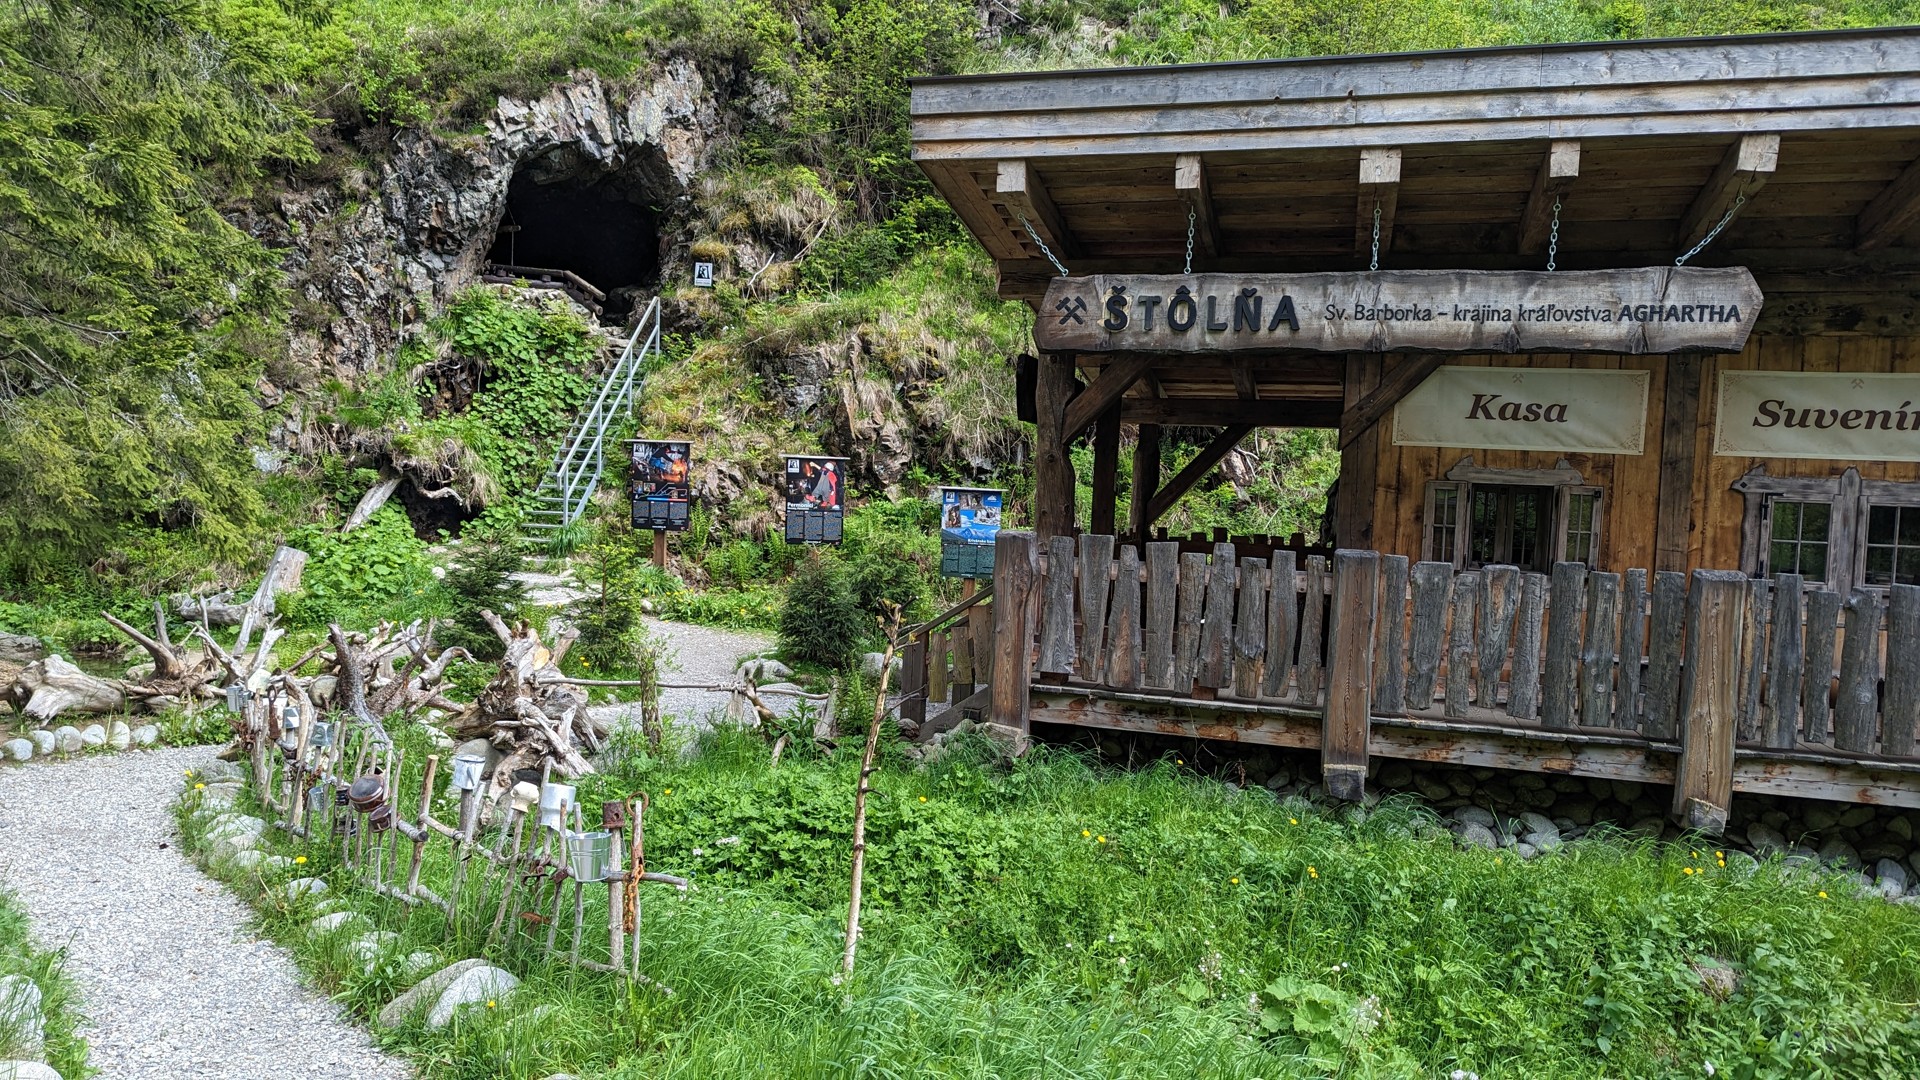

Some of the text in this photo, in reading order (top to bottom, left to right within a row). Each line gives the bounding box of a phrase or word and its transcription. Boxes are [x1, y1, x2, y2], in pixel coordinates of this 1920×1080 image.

[1104, 285, 1300, 332] ŠTÔLŇA
[1325, 304, 1349, 321] Sv.
[1354, 304, 1432, 321] Barborka
[1453, 304, 1512, 324] krajina
[1518, 303, 1612, 322] kráľovstva
[1617, 304, 1741, 323] AGHARTHA
[1465, 393, 1568, 423] Kasa
